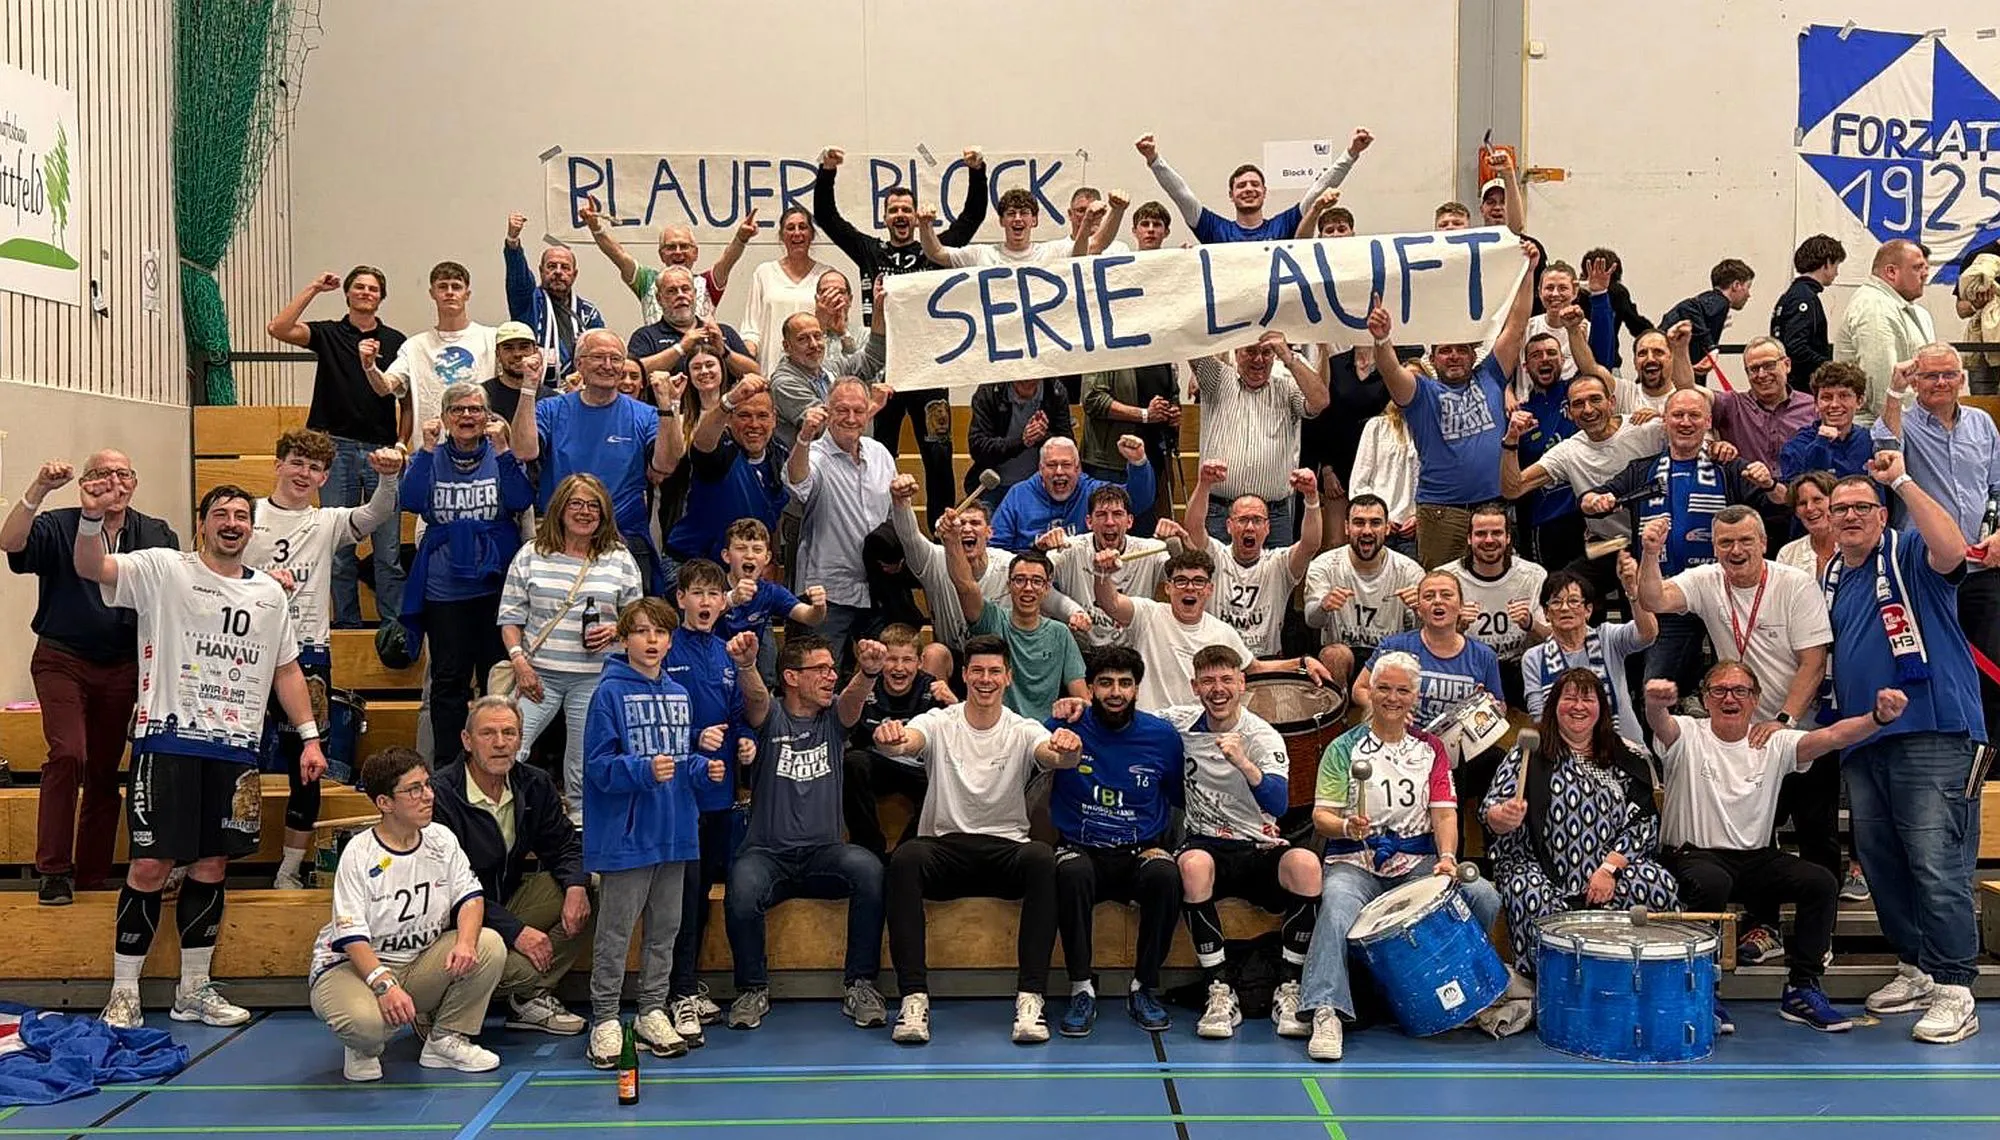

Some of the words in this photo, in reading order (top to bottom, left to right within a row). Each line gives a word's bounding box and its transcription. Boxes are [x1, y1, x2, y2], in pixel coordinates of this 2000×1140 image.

[0, 148, 43, 226] ttfeld
[568, 156, 819, 229] BLAUER
[870, 158, 1066, 230] BLOCK
[927, 255, 1152, 364] SERIE
[1199, 231, 1501, 335] LÄUFT
[433, 485, 498, 510] BLAUER
[273, 538, 290, 563] 3
[1230, 585, 1260, 609] 27
[221, 606, 251, 637] 10
[1354, 604, 1378, 628] 17
[1477, 611, 1508, 636] 20
[195, 640, 260, 665] HANAU
[200, 683, 221, 694] WIR
[1135, 774, 1149, 788] 16
[1380, 777, 1415, 808] 13
[394, 881, 431, 923] 27
